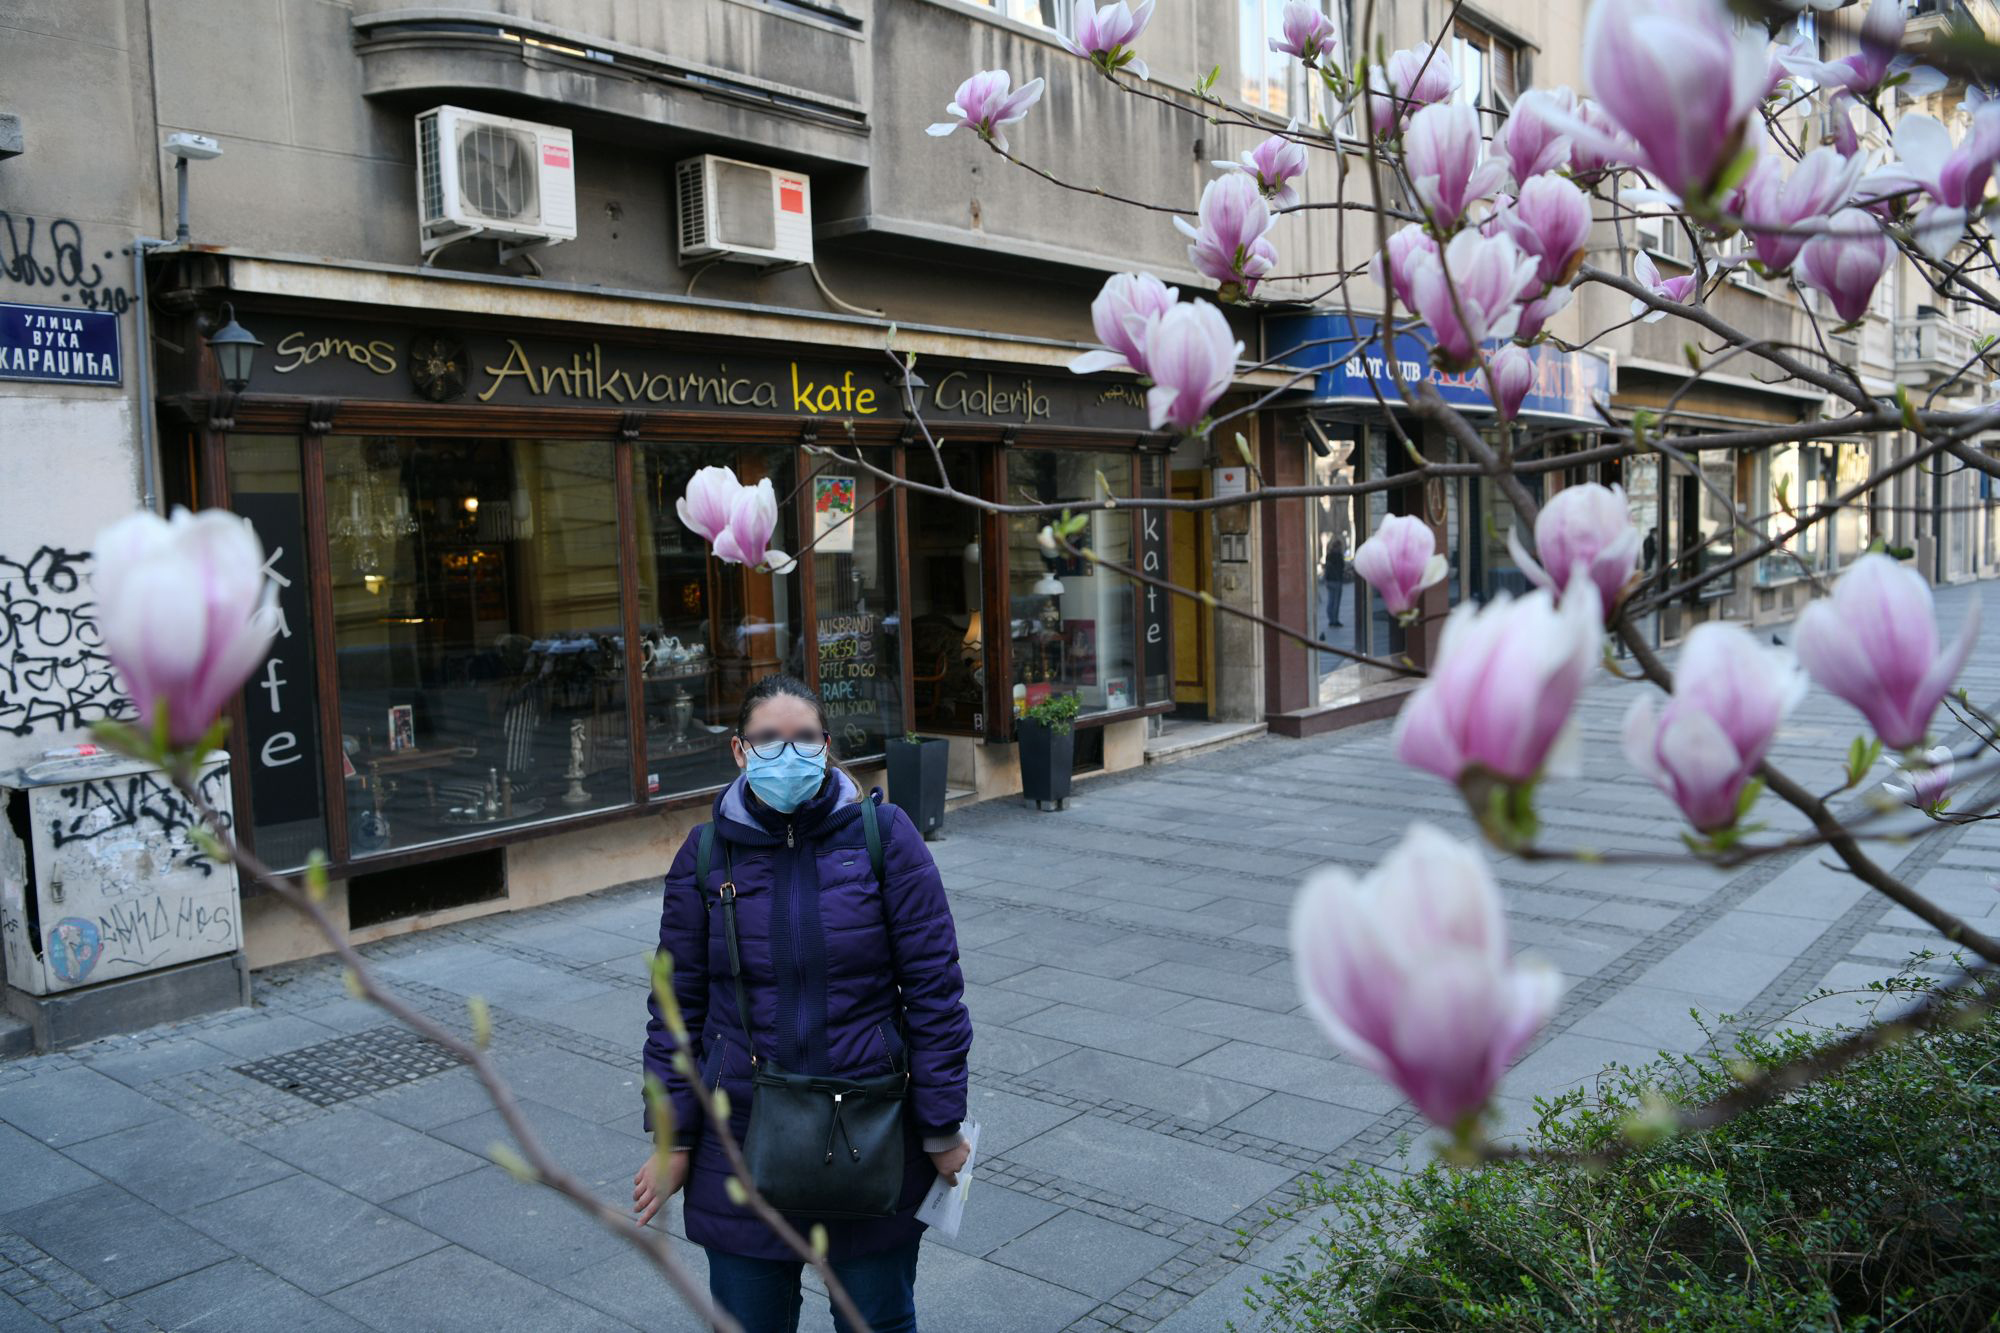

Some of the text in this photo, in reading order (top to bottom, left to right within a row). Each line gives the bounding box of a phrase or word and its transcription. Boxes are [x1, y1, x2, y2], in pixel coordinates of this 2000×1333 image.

[24, 314, 83, 332] УЛИЦА
[33, 331, 79, 348] ВУКА
[0, 346, 114, 376] КАРАЏИЋА
[1345, 357, 1383, 379] SLOT
[1386, 361, 1421, 383] CUB
[478, 339, 778, 408] Antikvarnica
[791, 362, 877, 414] kafe
[935, 371, 1051, 424] Galerija
[817, 615, 874, 637] AUSBRANDT
[818, 639, 858, 659] SPRESSO
[819, 661, 844, 679] OFFEE
[822, 680, 855, 702] RAPE
